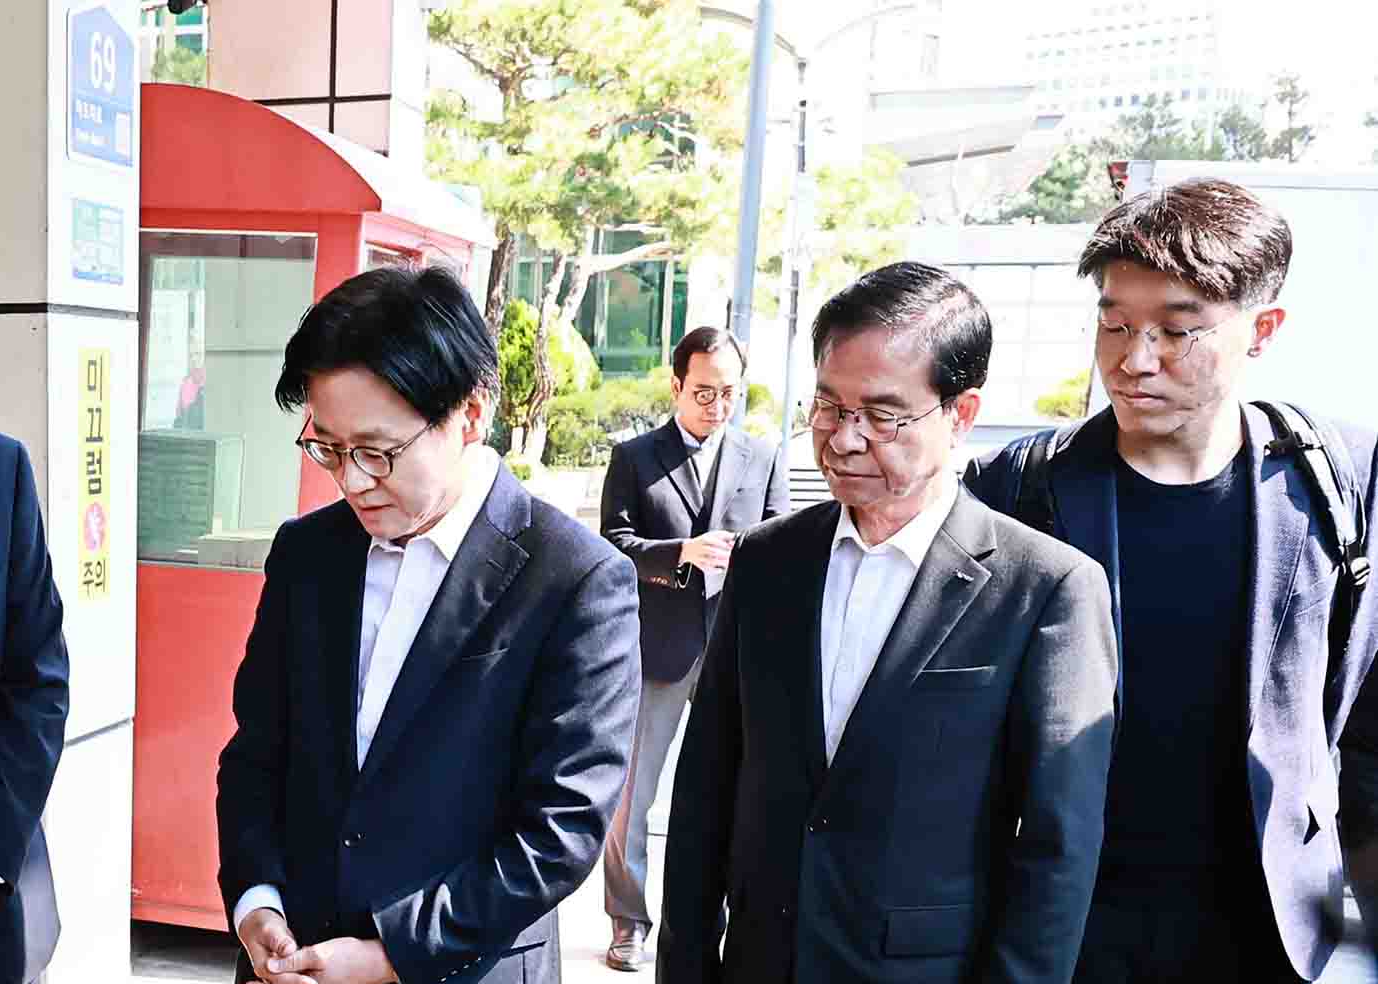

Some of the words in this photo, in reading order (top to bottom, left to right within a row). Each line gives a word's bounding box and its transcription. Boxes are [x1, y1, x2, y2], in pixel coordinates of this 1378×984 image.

[90, 32, 116, 95] 69
[85, 353, 104, 495] 미끄럼
[82, 557, 106, 599] 주의
